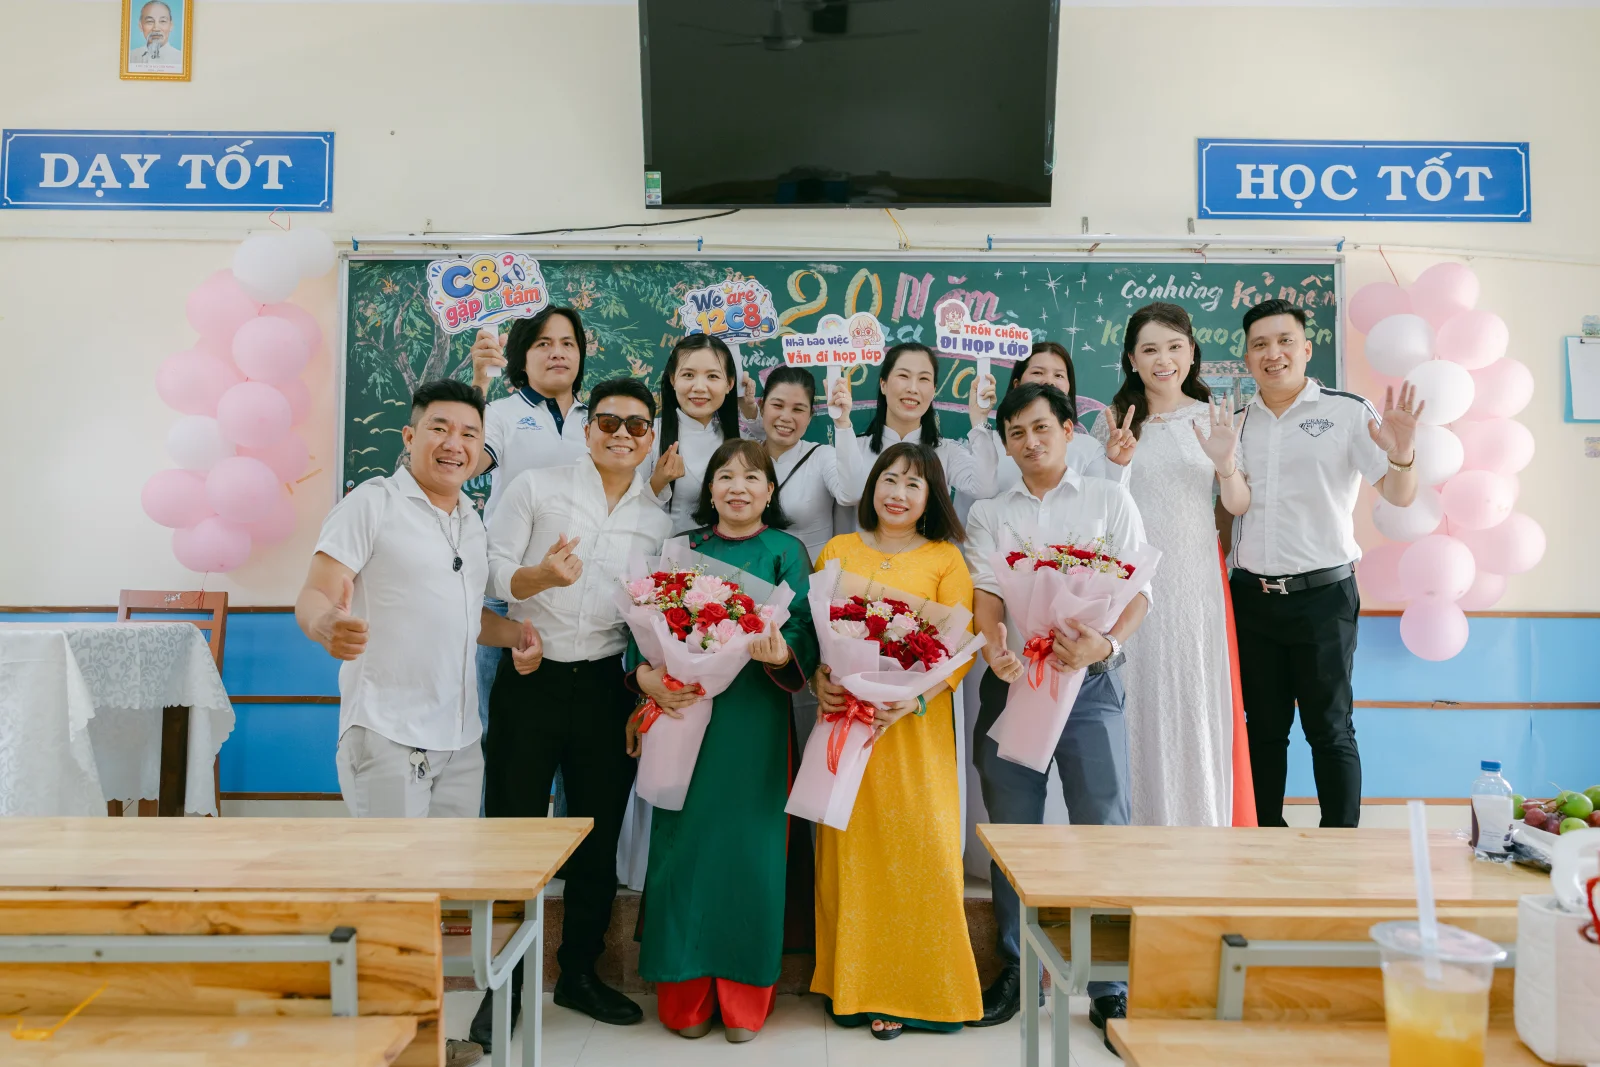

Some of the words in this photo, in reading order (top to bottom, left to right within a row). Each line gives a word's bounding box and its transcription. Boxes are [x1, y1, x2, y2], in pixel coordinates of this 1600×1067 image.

[39, 152, 161, 198] DẠY
[177, 139, 293, 190] TỐT
[1236, 163, 1358, 209] HỌC
[1377, 151, 1493, 202] TỐT
[441, 258, 501, 299] C8
[1120, 274, 1157, 299] Có
[445, 298, 481, 327] gặp
[483, 292, 502, 312] là
[502, 284, 541, 307] tám
[690, 289, 724, 312] We
[726, 289, 756, 305] are
[773, 268, 883, 334] 20
[696, 302, 761, 335] 12C8
[963, 323, 991, 336] TRỐN
[994, 326, 1029, 340] CHỒNG
[785, 336, 804, 347] Nhà
[807, 337, 825, 346] bao
[828, 335, 849, 346] việc
[940, 335, 958, 350] ĐI
[961, 337, 995, 355] HỌP
[998, 340, 1029, 357] LỚP
[787, 350, 811, 364] Vẫn
[816, 350, 829, 362] đi
[833, 350, 856, 364] họp
[861, 349, 882, 362] lớp
